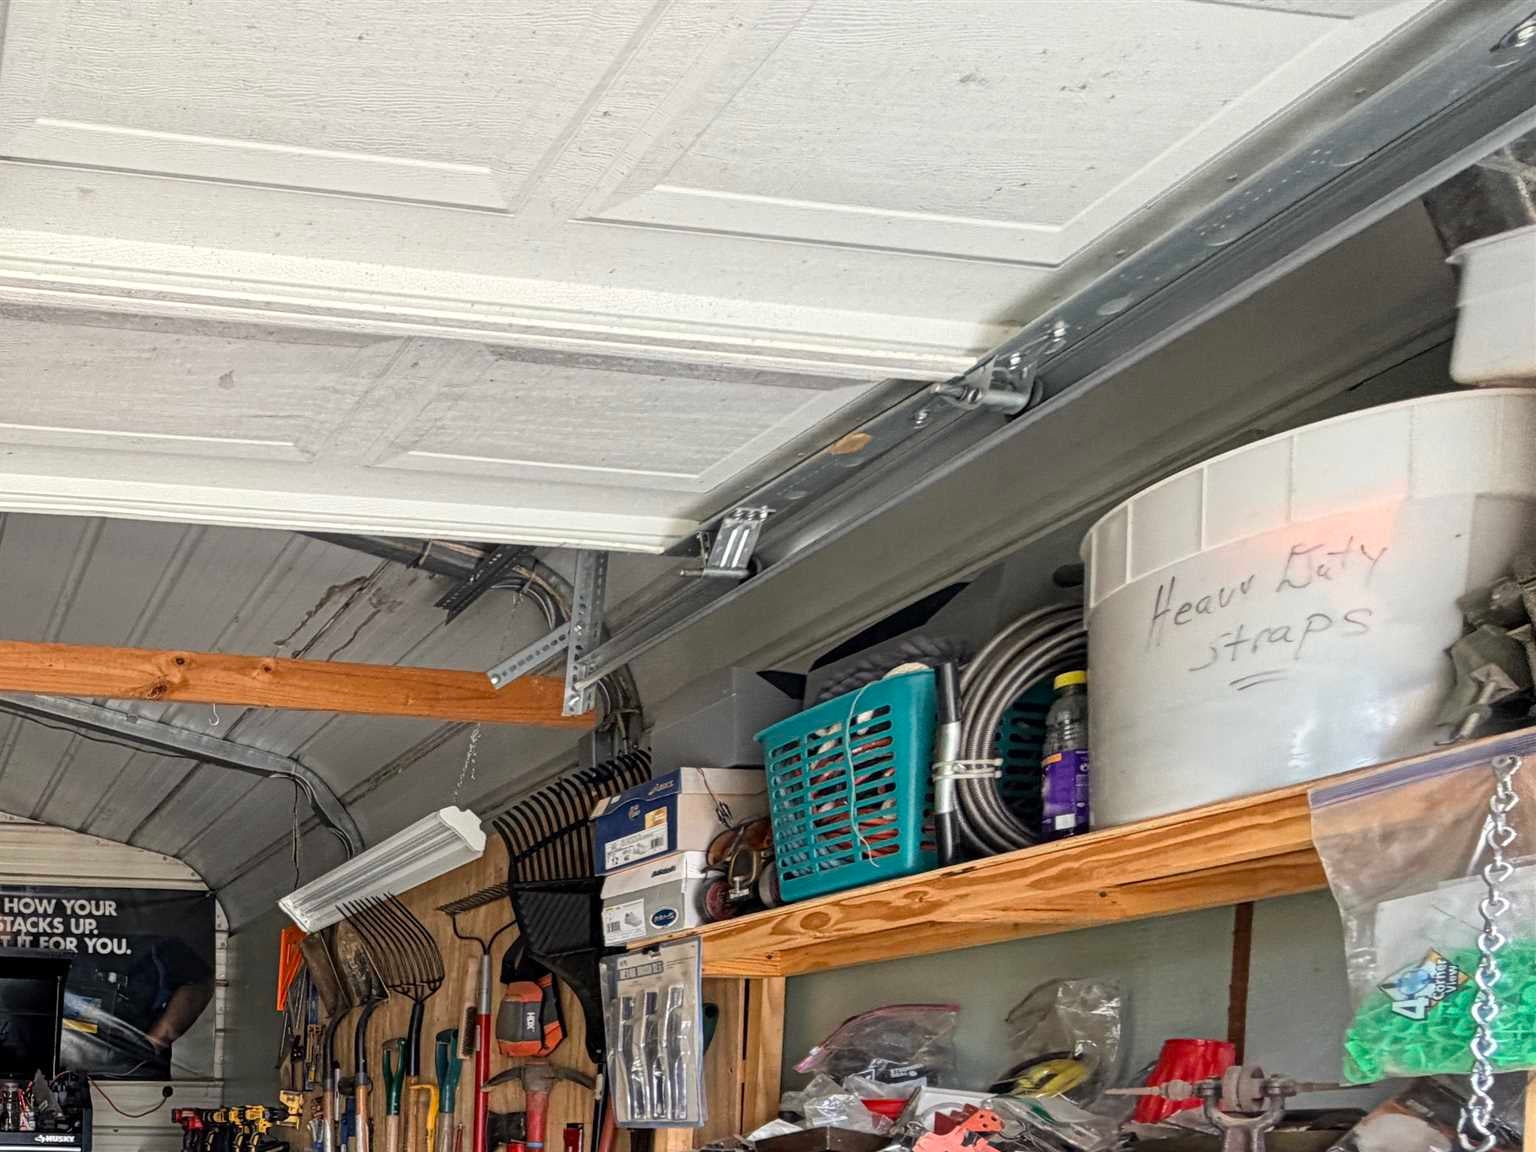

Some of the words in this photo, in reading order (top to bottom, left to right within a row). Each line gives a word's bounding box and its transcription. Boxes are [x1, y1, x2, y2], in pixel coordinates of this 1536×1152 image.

[1276, 535, 1388, 592] Duty
[4, 898, 56, 914] HOW
[62, 900, 117, 916] YOUR
[70, 918, 99, 935] UP.
[17, 935, 33, 949] IT
[39, 937, 78, 953] FOR
[84, 937, 133, 956] YOU.
[1432, 959, 1447, 1001] Corner
[45, 1135, 75, 1143] HUSKY
